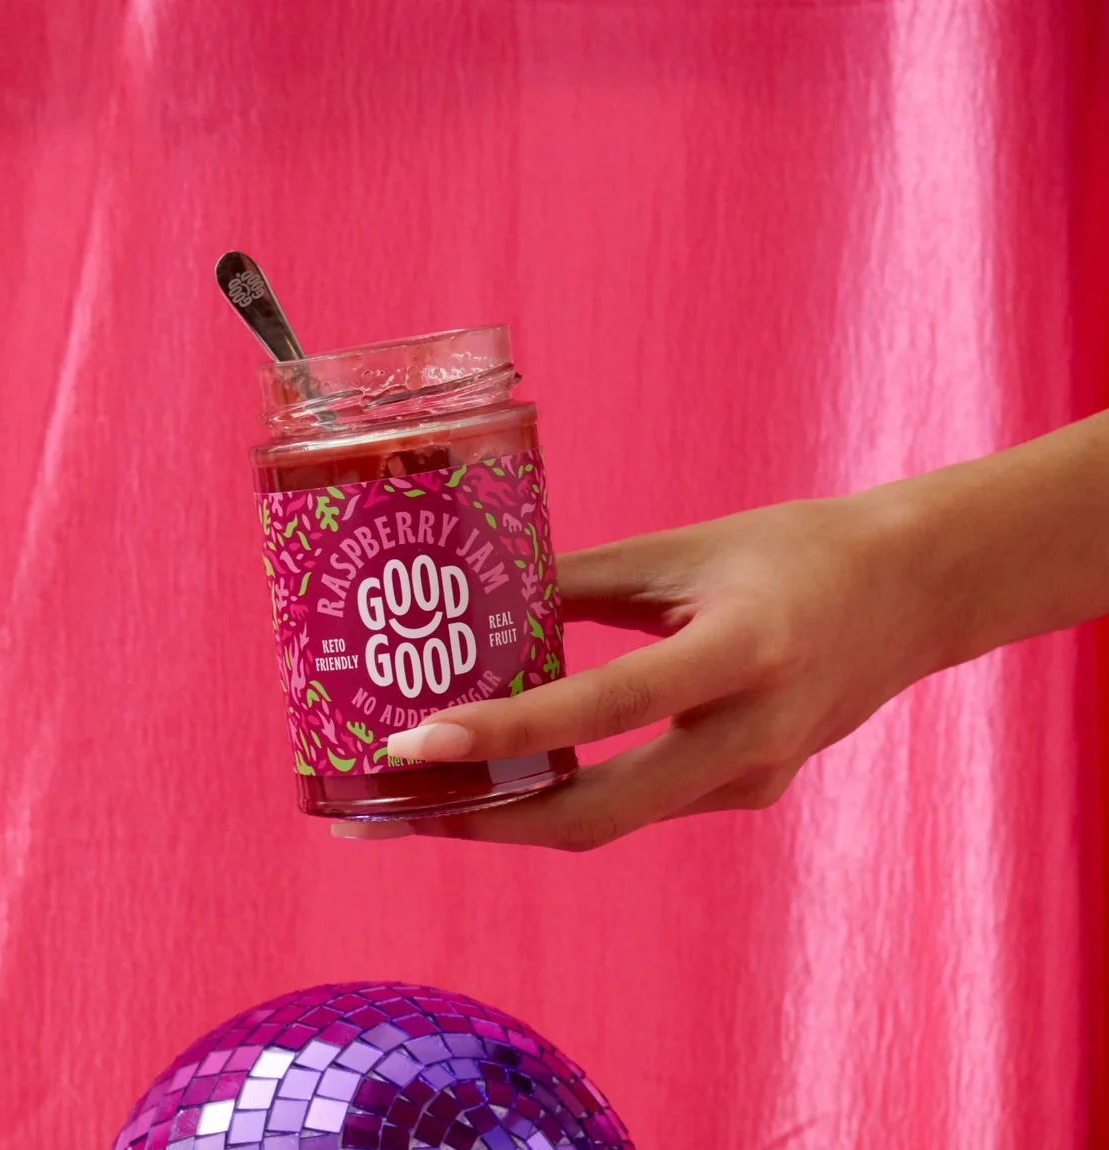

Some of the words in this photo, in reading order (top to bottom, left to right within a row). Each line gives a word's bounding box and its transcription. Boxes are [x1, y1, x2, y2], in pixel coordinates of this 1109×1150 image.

[317, 510, 459, 618] RASPBERRY
[456, 528, 510, 594] JAM
[357, 555, 469, 630] GOOD
[488, 611, 514, 629] REAL
[322, 638, 346, 654] KETO
[489, 628, 517, 648] FRUIT
[315, 655, 359, 672] FRIENDLY
[365, 622, 477, 698] GOOD
[351, 687, 377, 716] NO
[379, 704, 439, 729] ADDE
